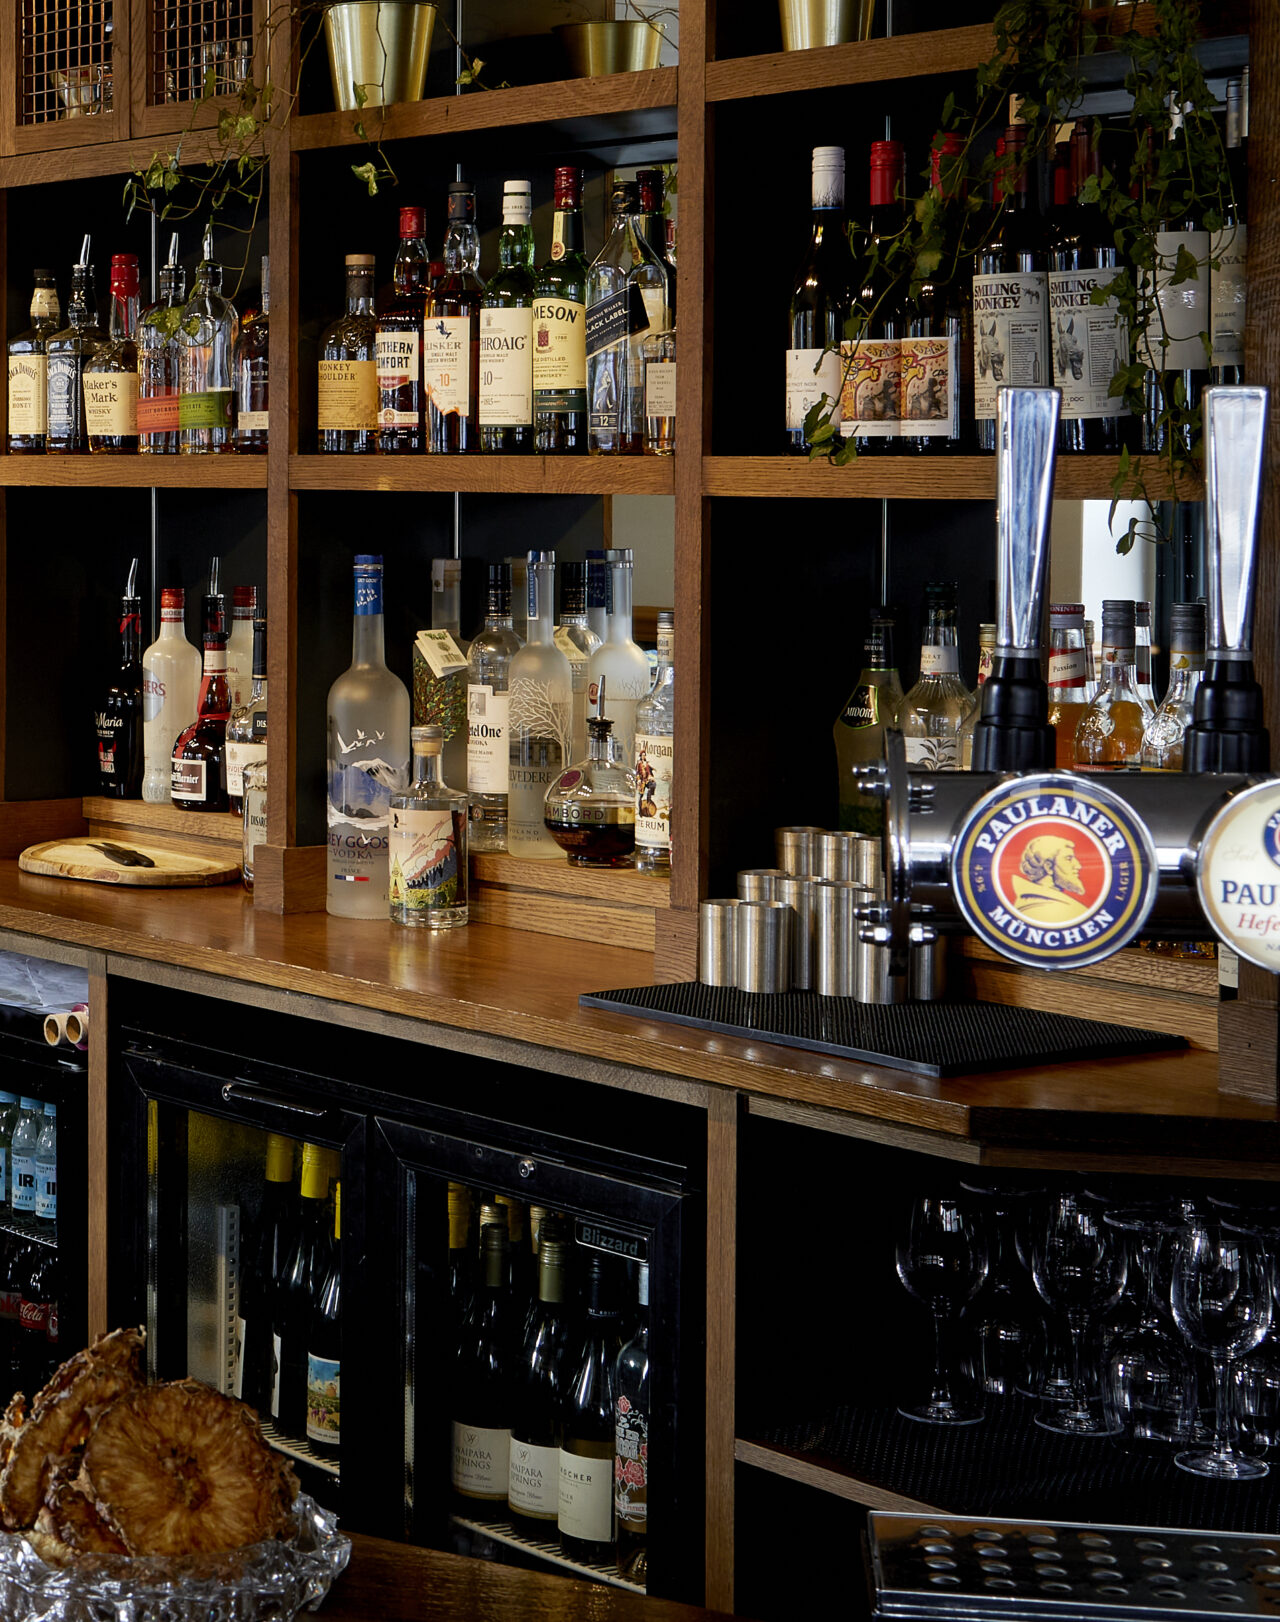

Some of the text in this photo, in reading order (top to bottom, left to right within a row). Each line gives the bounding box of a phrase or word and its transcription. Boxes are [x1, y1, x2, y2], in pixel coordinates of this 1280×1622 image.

[975, 283, 1020, 297] SMILING
[1051, 279, 1098, 294] SMILING
[974, 296, 1021, 311] DONKEY
[1051, 293, 1090, 308] DONKE
[604, 308, 628, 323] LABEL
[440, 374, 450, 386] 10
[483, 371, 493, 386] 10
[91, 392, 118, 403] Mark
[600, 416, 609, 426] 12
[1052, 661, 1078, 673] Passion
[99, 712, 124, 728] Maria
[257, 720, 267, 728] DIS
[481, 724, 502, 738] One
[643, 740, 673, 758] Morgan
[645, 821, 665, 832] RUM
[975, 796, 1126, 856] PAULANER
[345, 836, 389, 849] GOOS
[332, 847, 373, 860] VODKA
[974, 863, 987, 894] 4.9%
[1114, 860, 1130, 902] LAGER
[1220, 879, 1280, 906] PAU
[987, 905, 1115, 947] MÜNCHEN
[581, 1225, 639, 1256] Blizzard
